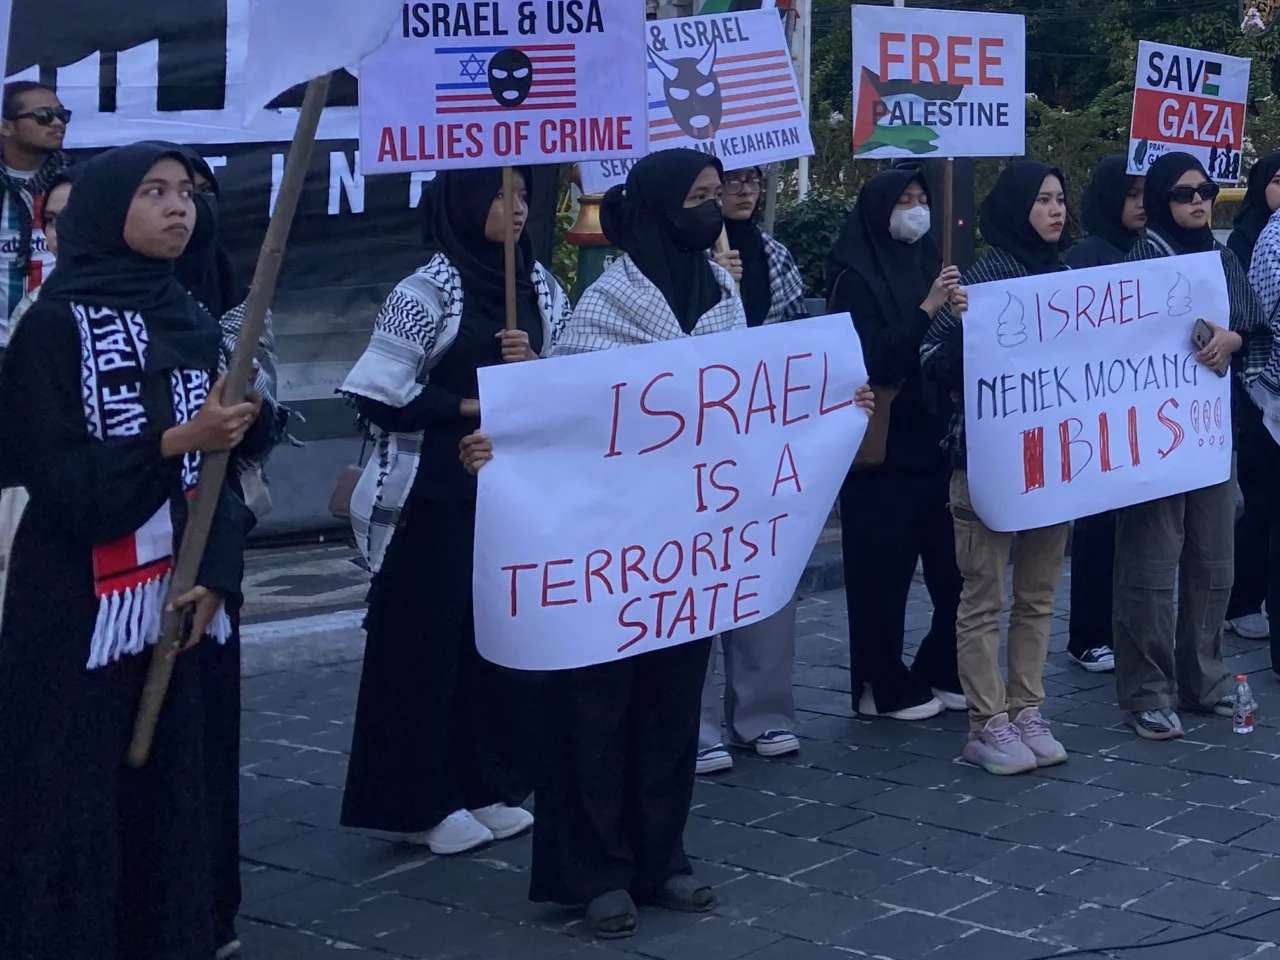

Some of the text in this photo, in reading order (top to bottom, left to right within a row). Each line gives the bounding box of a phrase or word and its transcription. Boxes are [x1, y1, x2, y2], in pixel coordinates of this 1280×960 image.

[402, 0, 604, 38] ISRAEL & USA
[651, 16, 749, 52] & ISRAEL
[879, 32, 1004, 87] FREE
[378, 116, 632, 162] ALLIES OF CRIME
[721, 126, 801, 157] KEJAHATAN
[872, 100, 1009, 128] PALESTINE
[1158, 98, 1235, 144] GAZA
[1036, 279, 1159, 343] ISRAEL
[102, 381, 148, 437] AVE
[604, 352, 853, 458] ISRAEL
[976, 351, 1199, 420] NENEK MOYANG
[693, 443, 802, 513] IS A
[501, 513, 789, 617] TERRORIST
[618, 575, 761, 652] STATE
